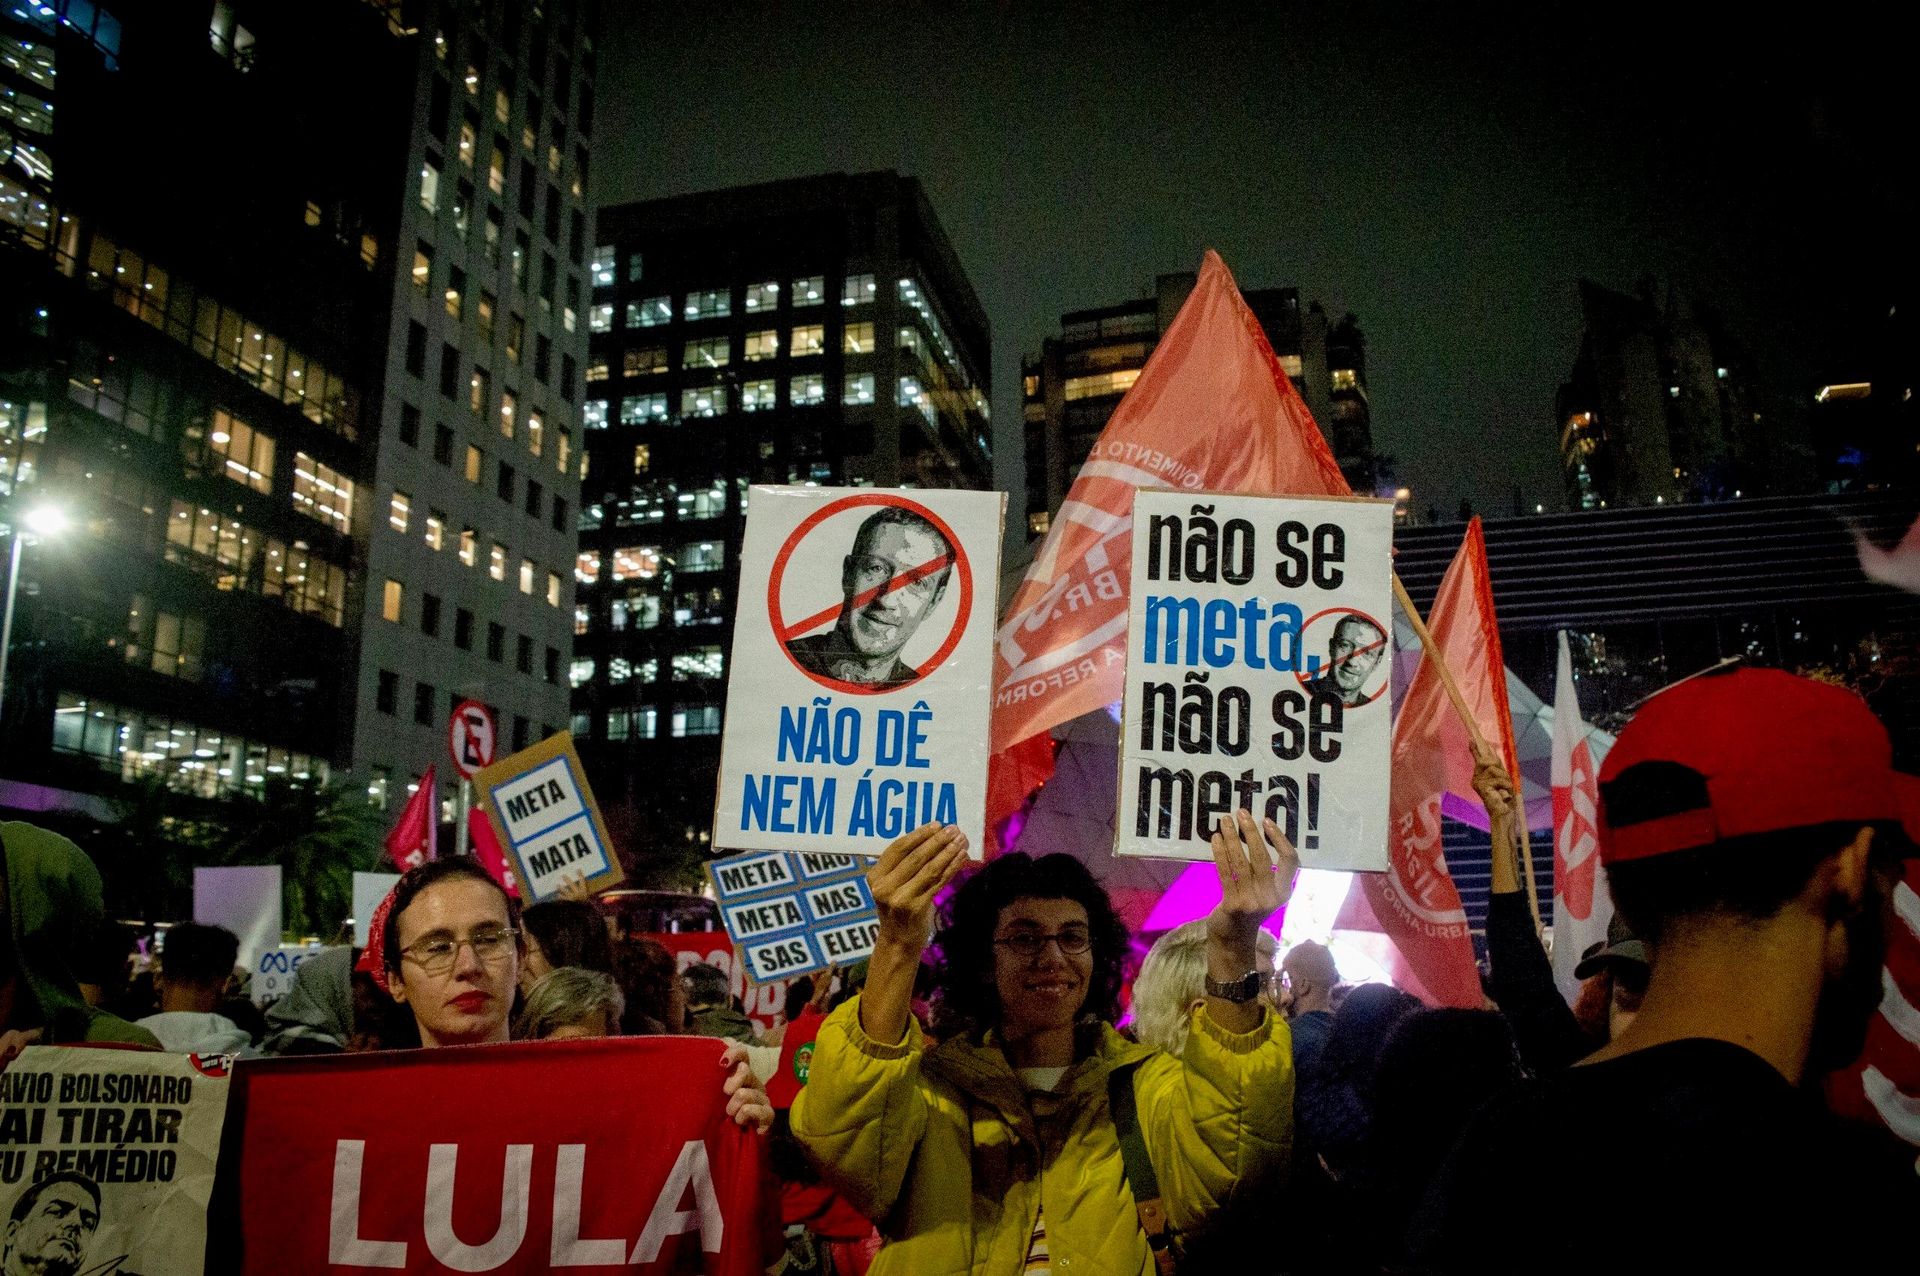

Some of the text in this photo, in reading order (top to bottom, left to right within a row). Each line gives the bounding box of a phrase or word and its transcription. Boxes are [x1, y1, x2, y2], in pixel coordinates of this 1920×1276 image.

[1147, 504, 1345, 591] não se
[1143, 595, 1320, 682] meta,
[777, 696, 933, 769] NÃO DÊ
[1140, 671, 1344, 763] não se
[505, 778, 566, 823] META
[740, 768, 958, 840] NEM ÁGUA
[1136, 766, 1320, 850] meta!
[528, 833, 592, 879] MATA
[720, 859, 787, 892] META
[736, 886, 862, 934] META NAS
[758, 941, 809, 972] SAS
[59, 1072, 192, 1105] BOLSONARO
[0, 1108, 182, 1144] AI TIRAR
[32, 1143, 177, 1184] REMÉDIO
[328, 1139, 724, 1273] LULA
